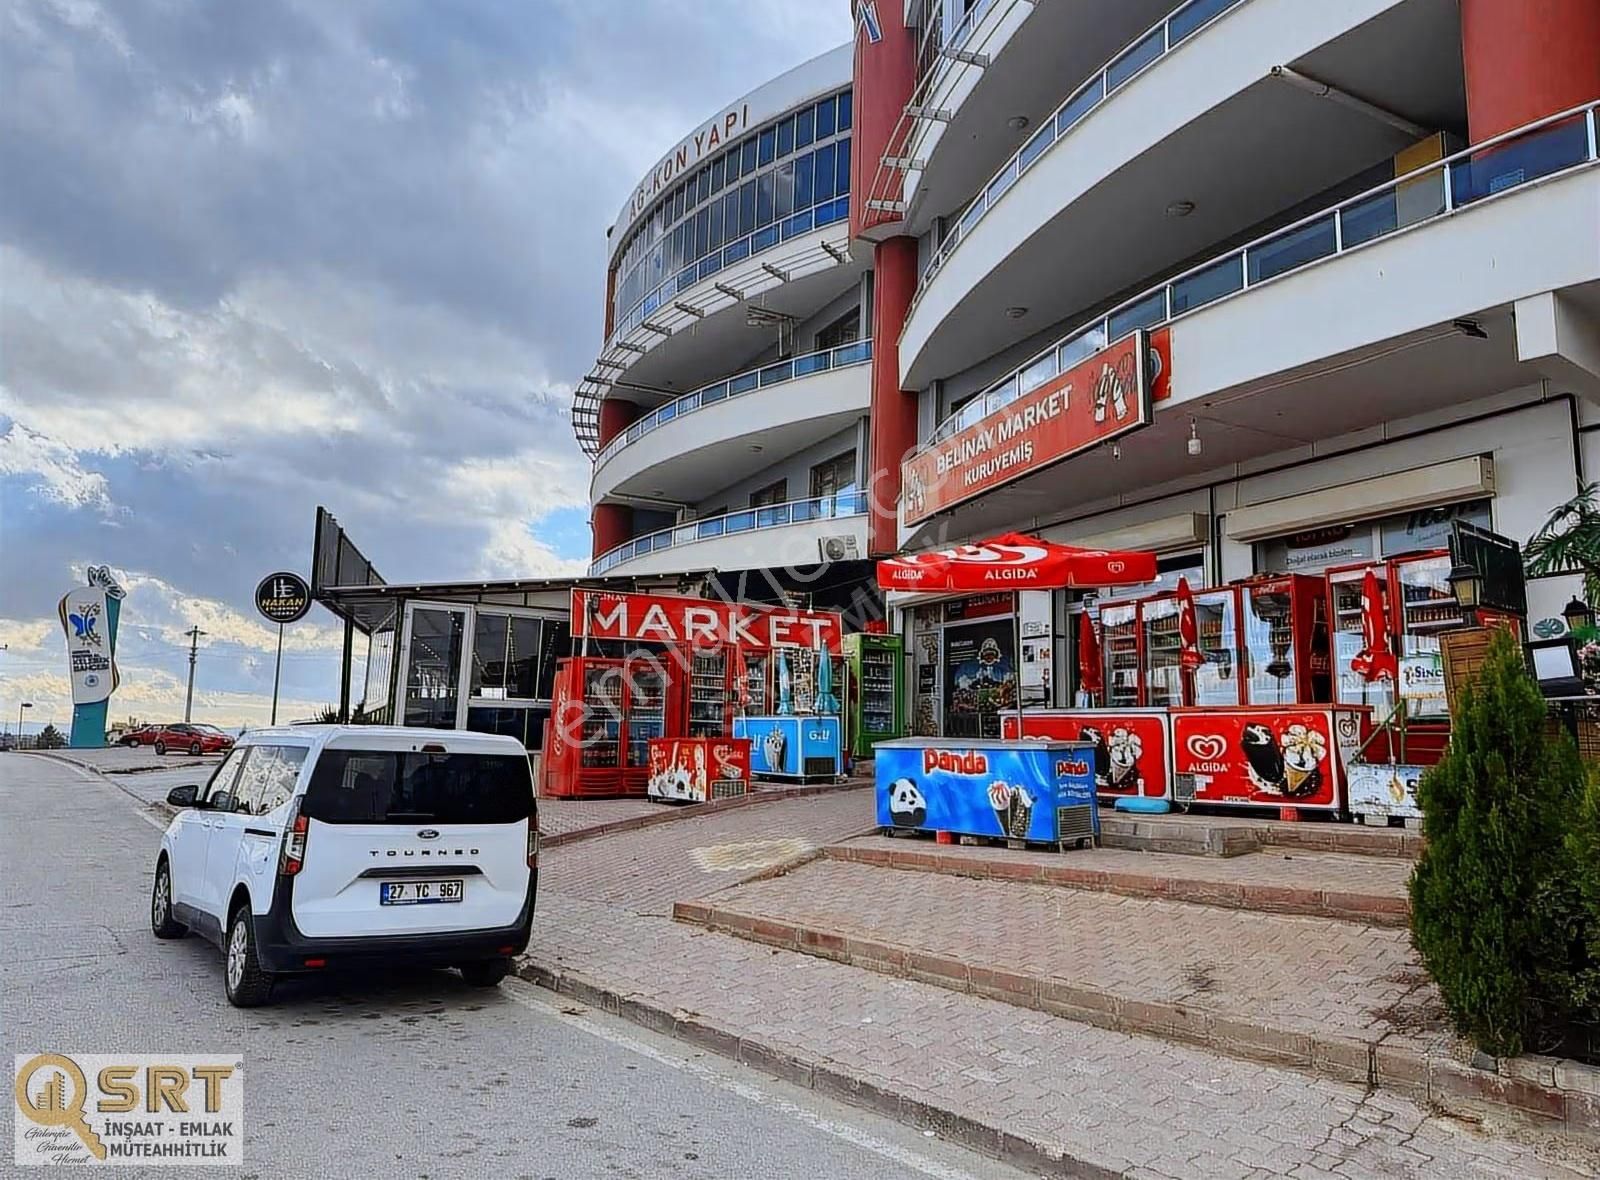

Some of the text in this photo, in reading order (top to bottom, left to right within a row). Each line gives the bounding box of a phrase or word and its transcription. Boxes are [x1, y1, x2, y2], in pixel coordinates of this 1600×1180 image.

[694, 104, 748, 157] YAPI
[936, 384, 1072, 475] BELİNAY MARKET
[964, 440, 1033, 486] KURUYEMİŞ
[584, 602, 832, 653] MARKET
[369, 848, 480, 857] TOURNEO
[390, 883, 460, 899] 27 YC 967
